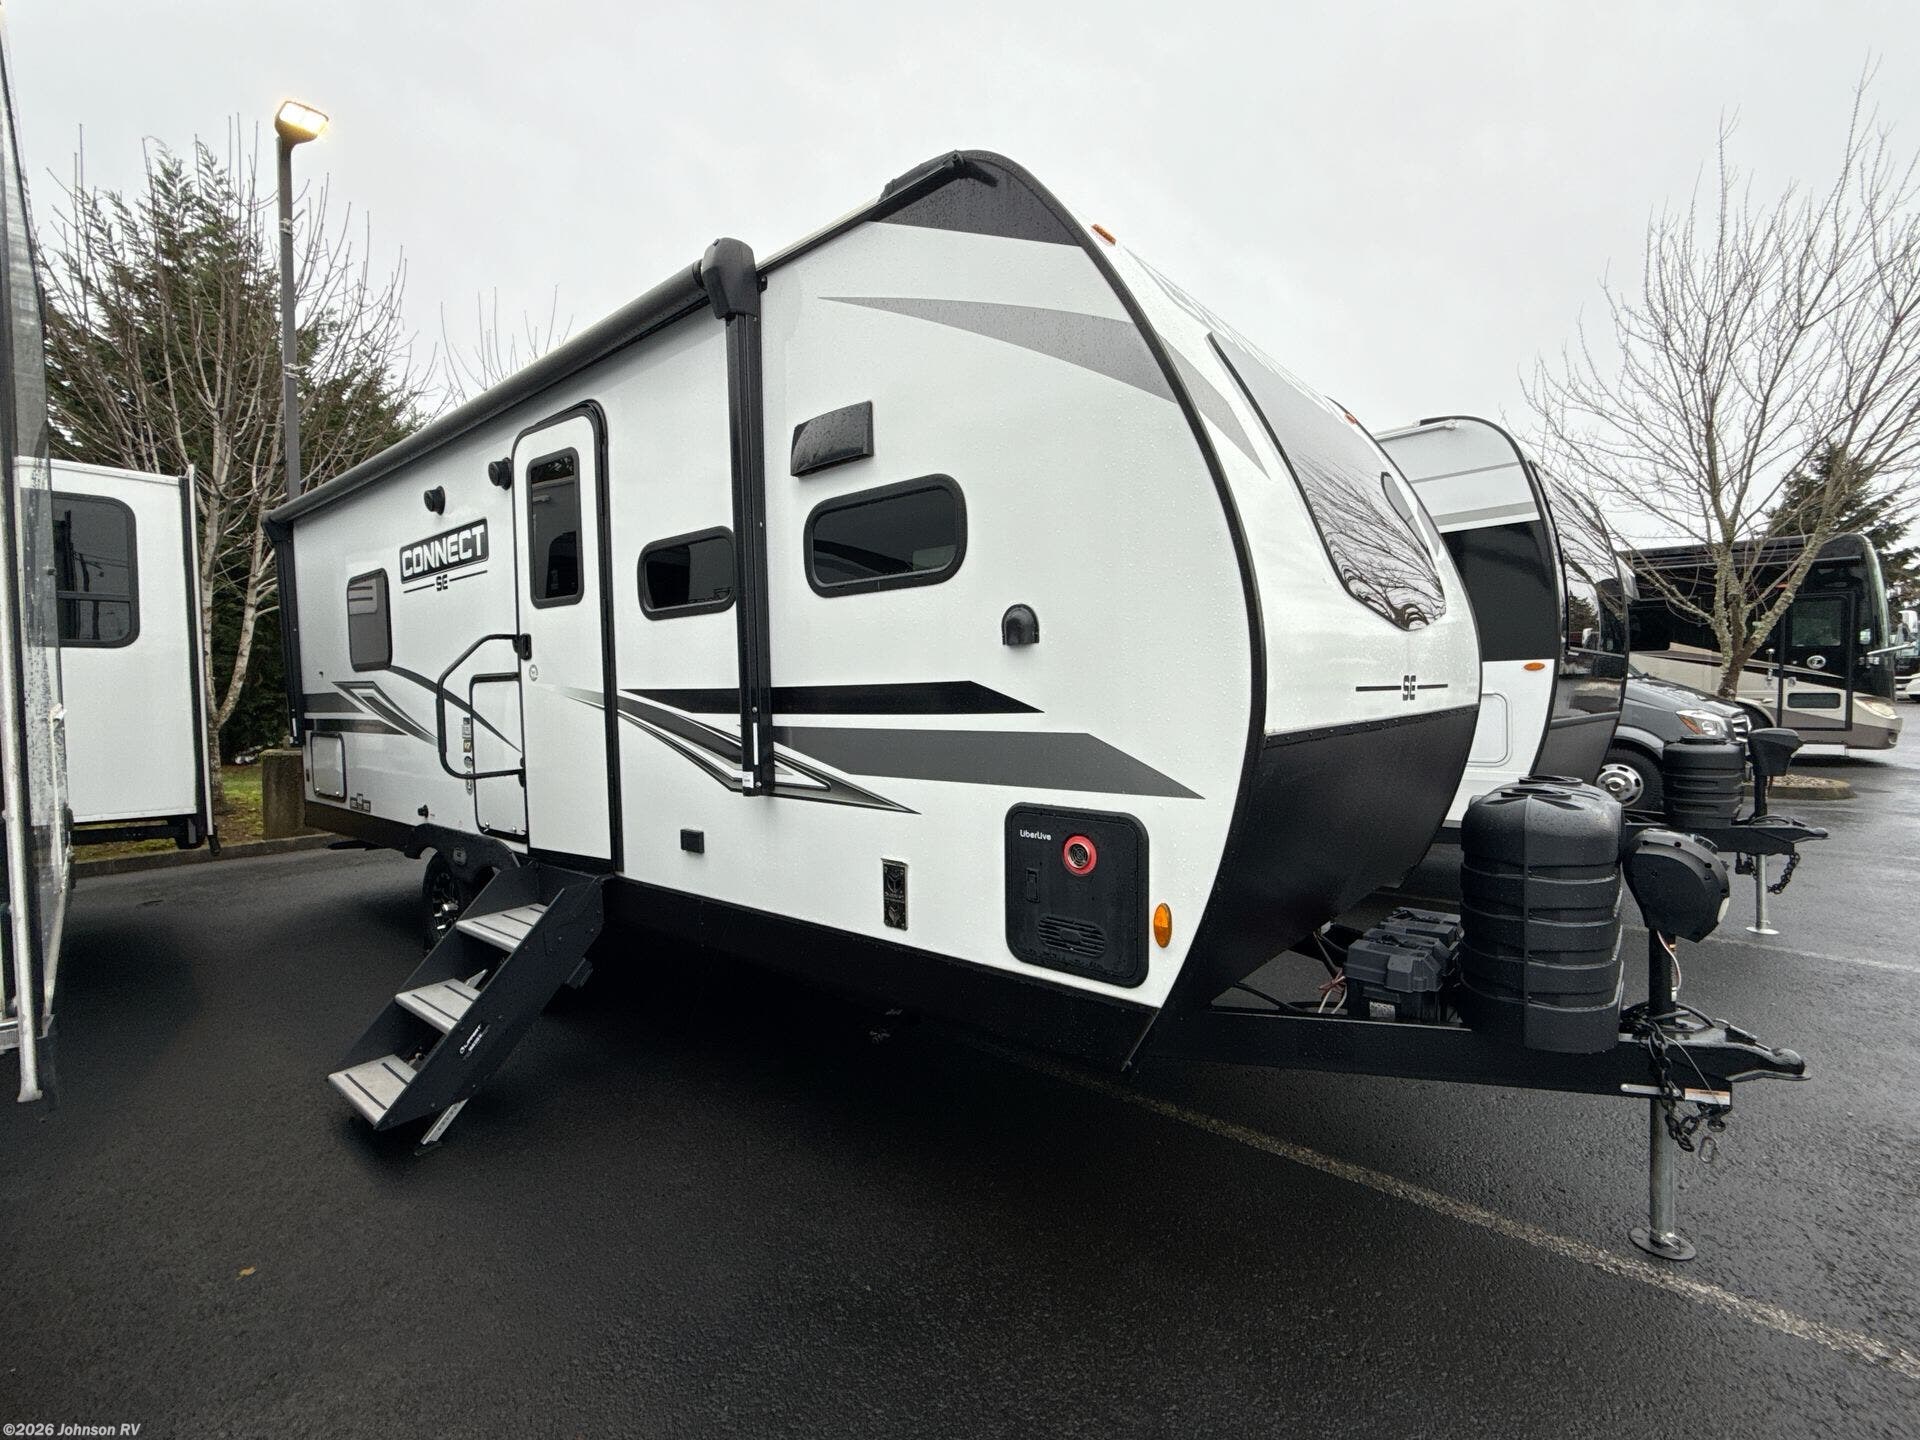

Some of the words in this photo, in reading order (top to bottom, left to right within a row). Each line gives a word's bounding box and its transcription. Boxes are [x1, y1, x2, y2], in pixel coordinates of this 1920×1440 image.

[402, 524, 485, 577] CONNECT
[436, 574, 448, 592] SE
[1403, 675, 1416, 701] SE
